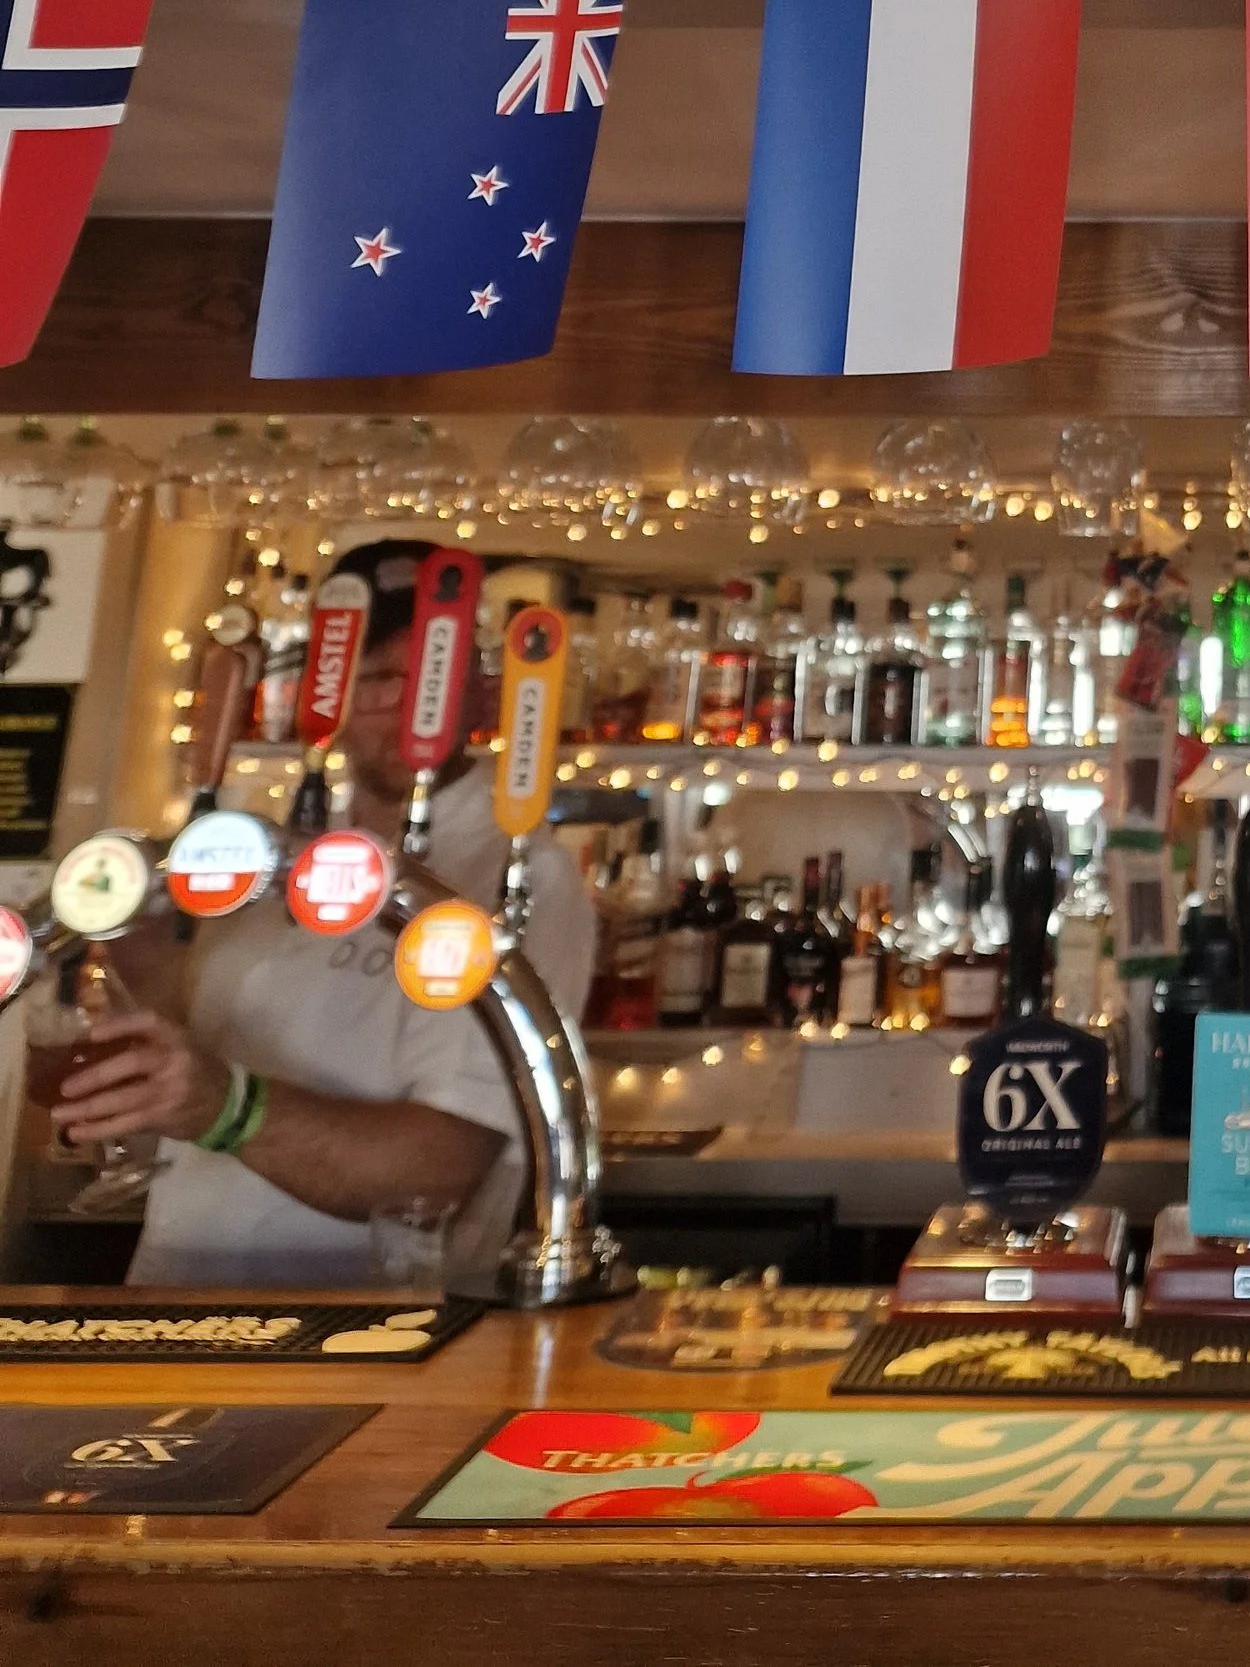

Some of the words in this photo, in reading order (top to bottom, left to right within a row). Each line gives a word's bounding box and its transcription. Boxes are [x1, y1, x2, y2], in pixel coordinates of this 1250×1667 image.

[310, 612, 353, 720] AMSTEL
[423, 624, 448, 728] CAMDEN
[516, 687, 539, 788] CAMDEN
[983, 1060, 1084, 1132] 6X
[981, 1138, 1051, 1153] ORIGINAL
[1055, 1137, 1081, 1151] ALE
[70, 1437, 201, 1462] 6X
[542, 1449, 847, 1469] THATCHERS
